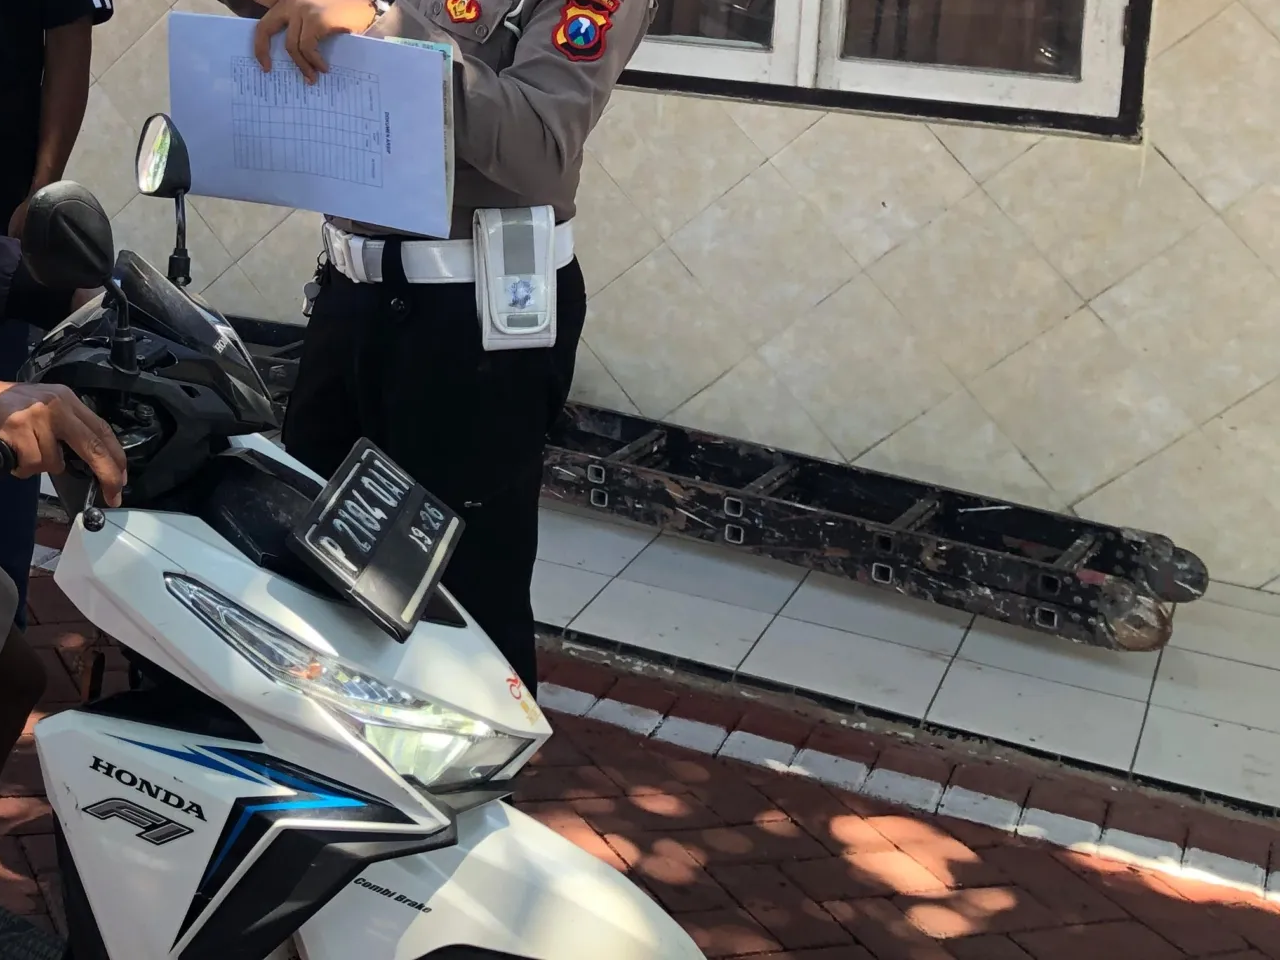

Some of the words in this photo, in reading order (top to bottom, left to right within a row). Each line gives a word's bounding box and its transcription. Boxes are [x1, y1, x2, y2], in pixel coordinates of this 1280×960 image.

[319, 536, 359, 572] P
[89, 755, 208, 823] HONDA
[353, 877, 398, 898] Combi
[393, 894, 433, 913] Brake
